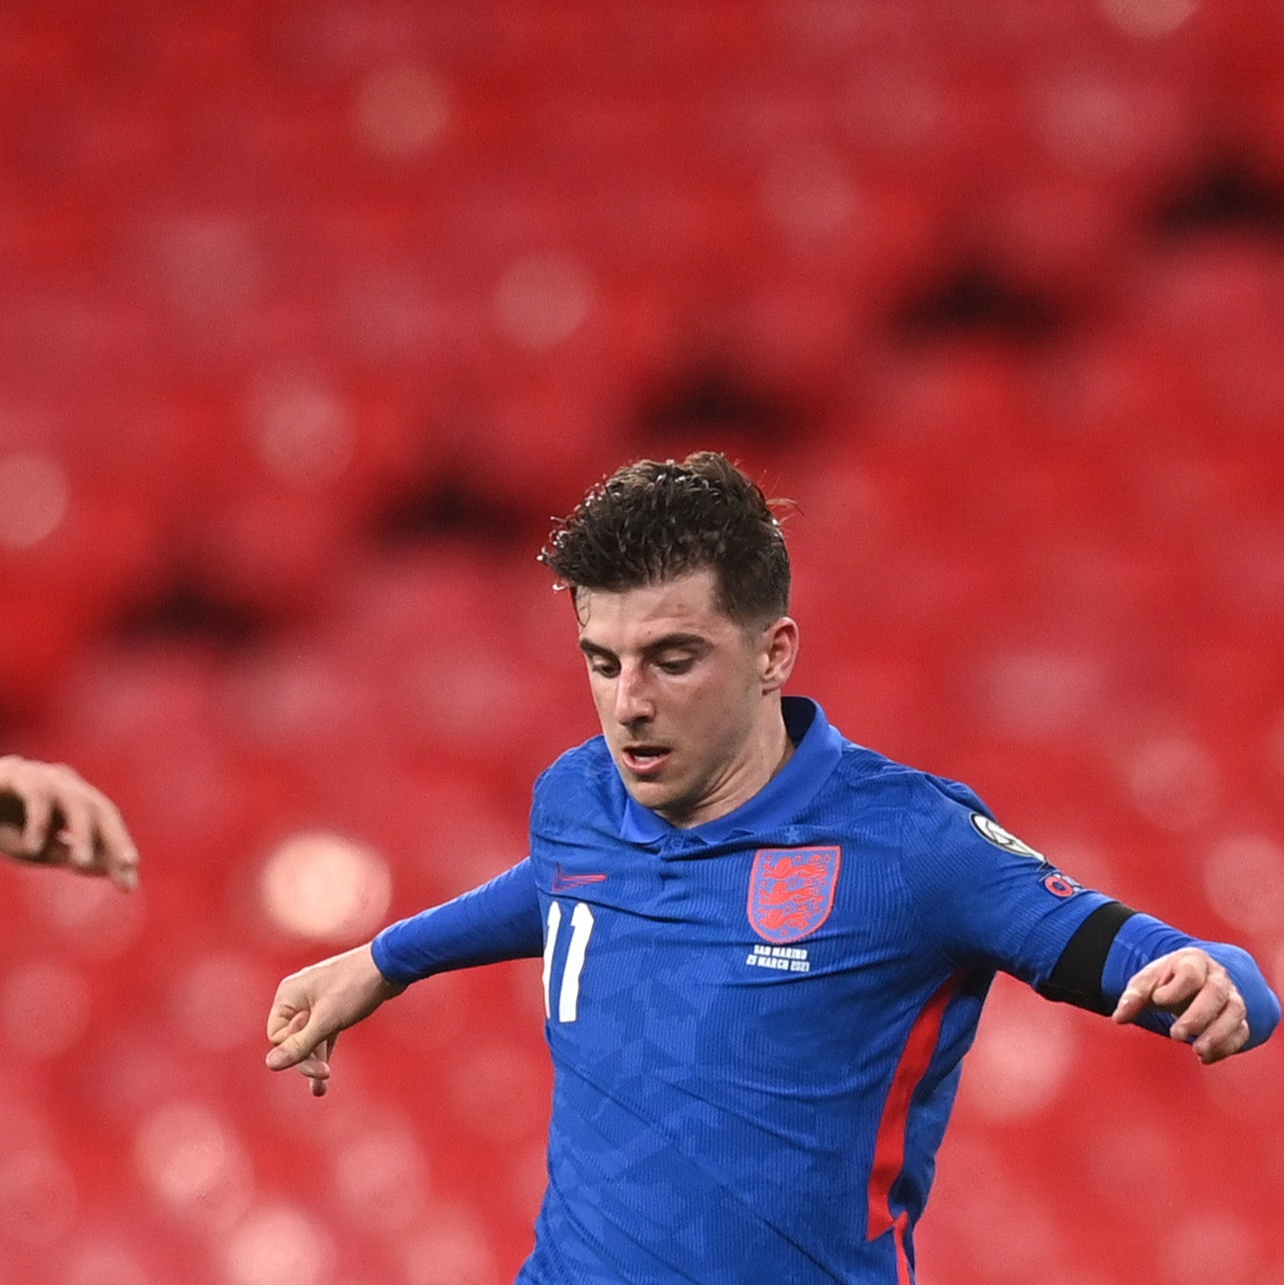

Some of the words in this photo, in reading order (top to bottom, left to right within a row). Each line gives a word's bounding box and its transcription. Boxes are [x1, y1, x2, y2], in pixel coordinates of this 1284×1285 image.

[753, 944, 771, 956] SAN
[772, 946, 808, 960] MARINO
[542, 901, 595, 1022] 11
[757, 956, 789, 970] MARCH
